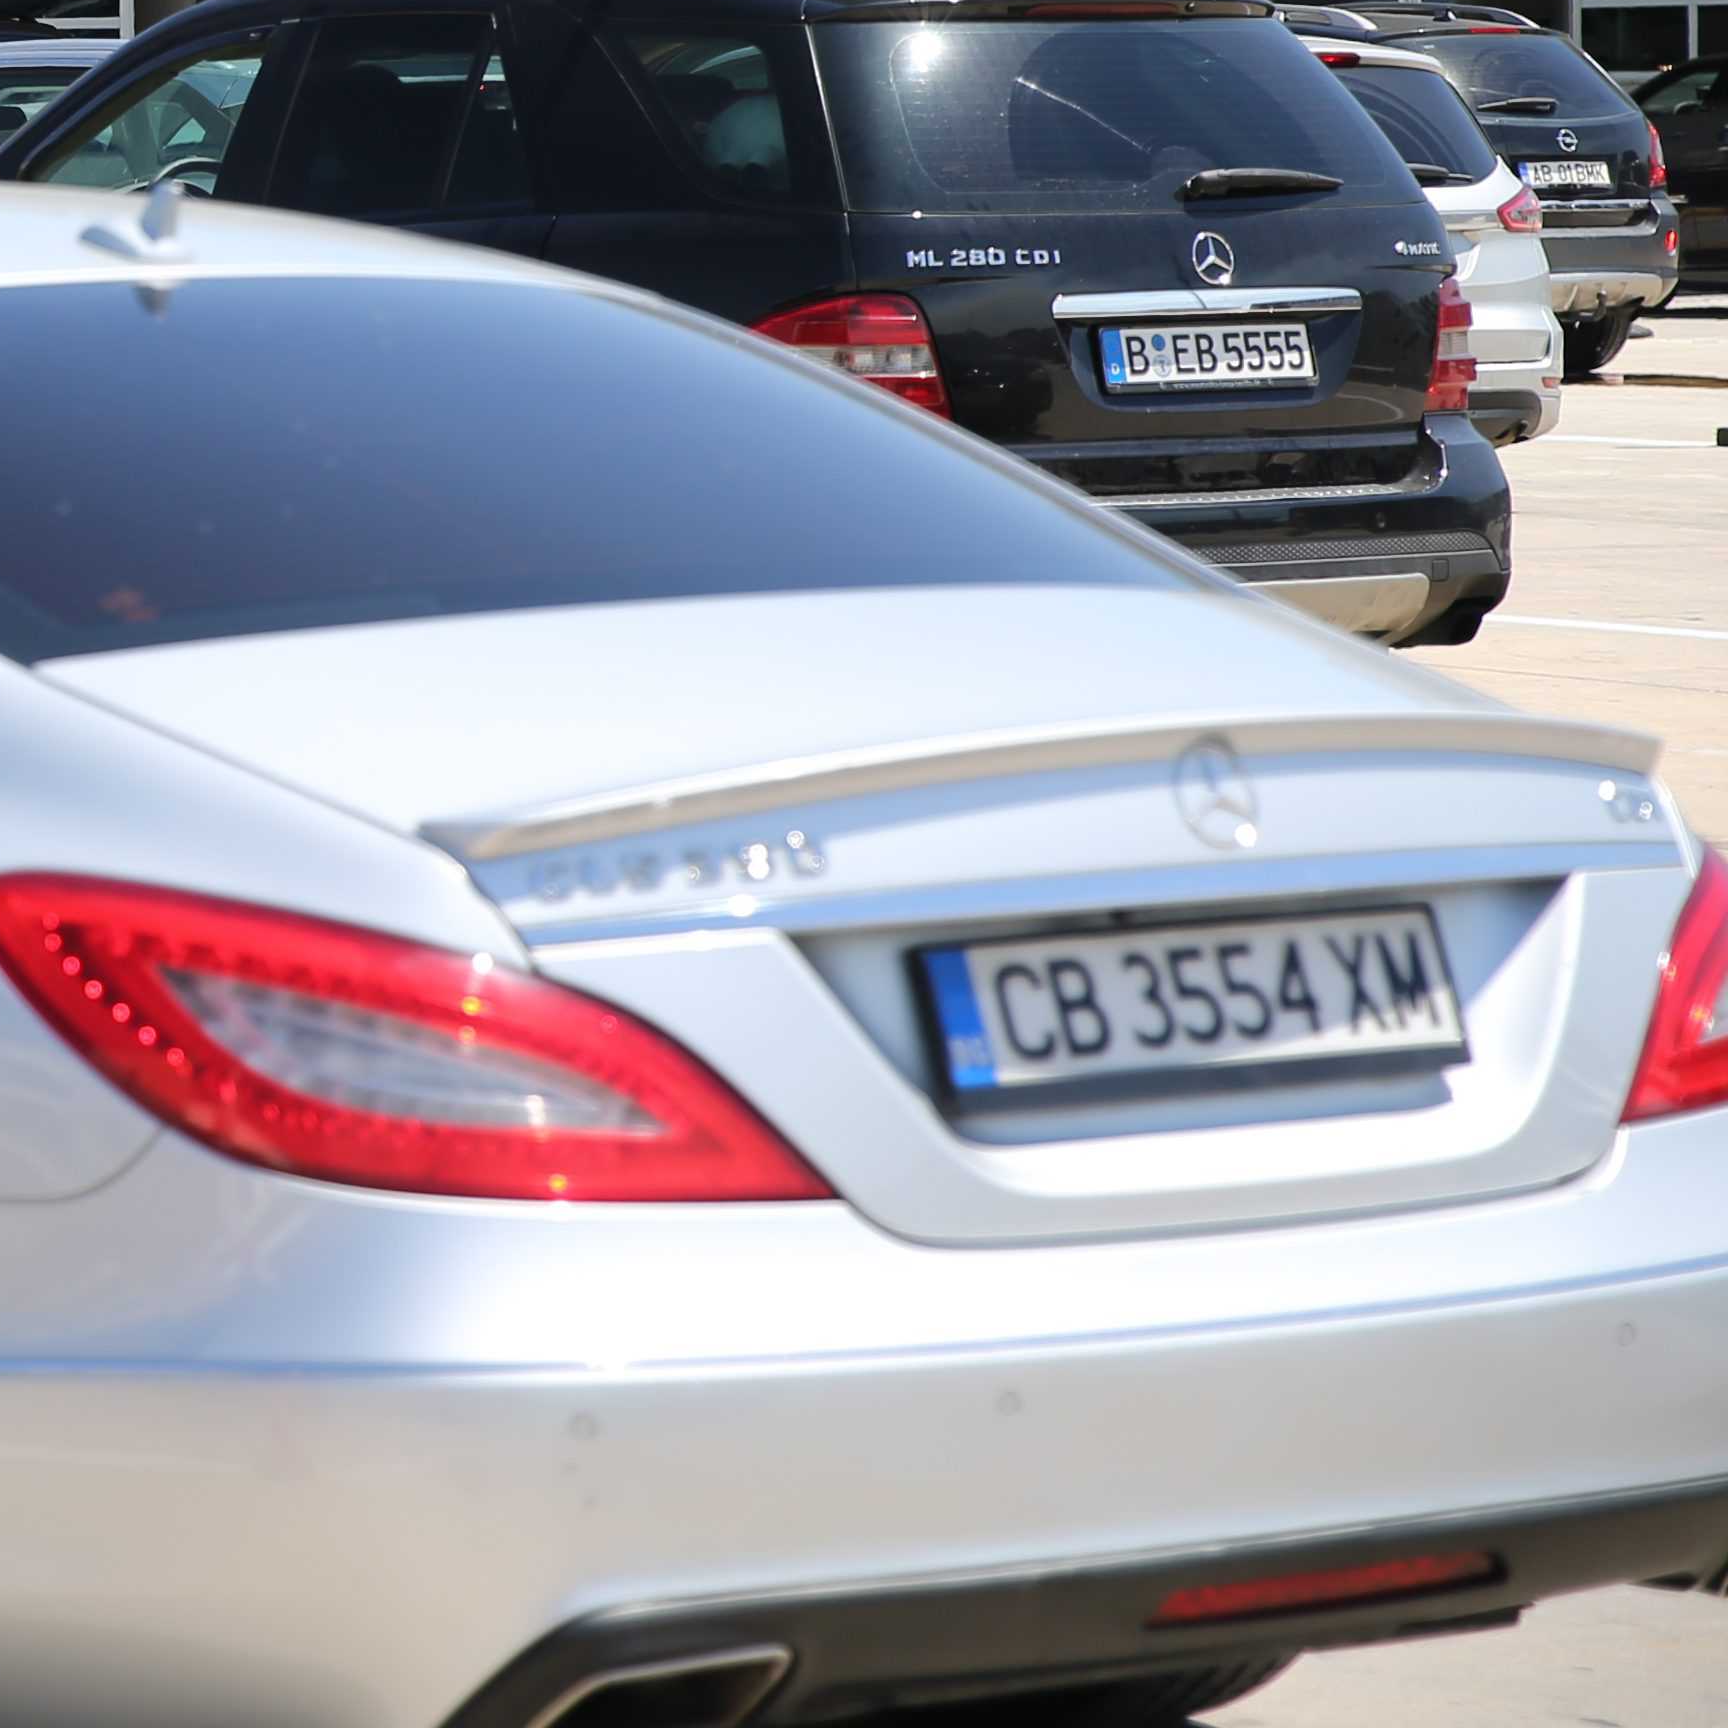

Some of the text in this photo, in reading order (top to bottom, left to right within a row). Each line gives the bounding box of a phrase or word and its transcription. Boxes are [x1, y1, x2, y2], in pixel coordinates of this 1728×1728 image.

[906, 246, 1061, 268] ML 280 CDI
[1124, 335, 1150, 376] B
[1172, 334, 1218, 375] EB
[1222, 330, 1305, 373] 5555
[994, 958, 1111, 1061] CB
[1122, 938, 1324, 1048] 3554
[1324, 928, 1442, 1036] XM
